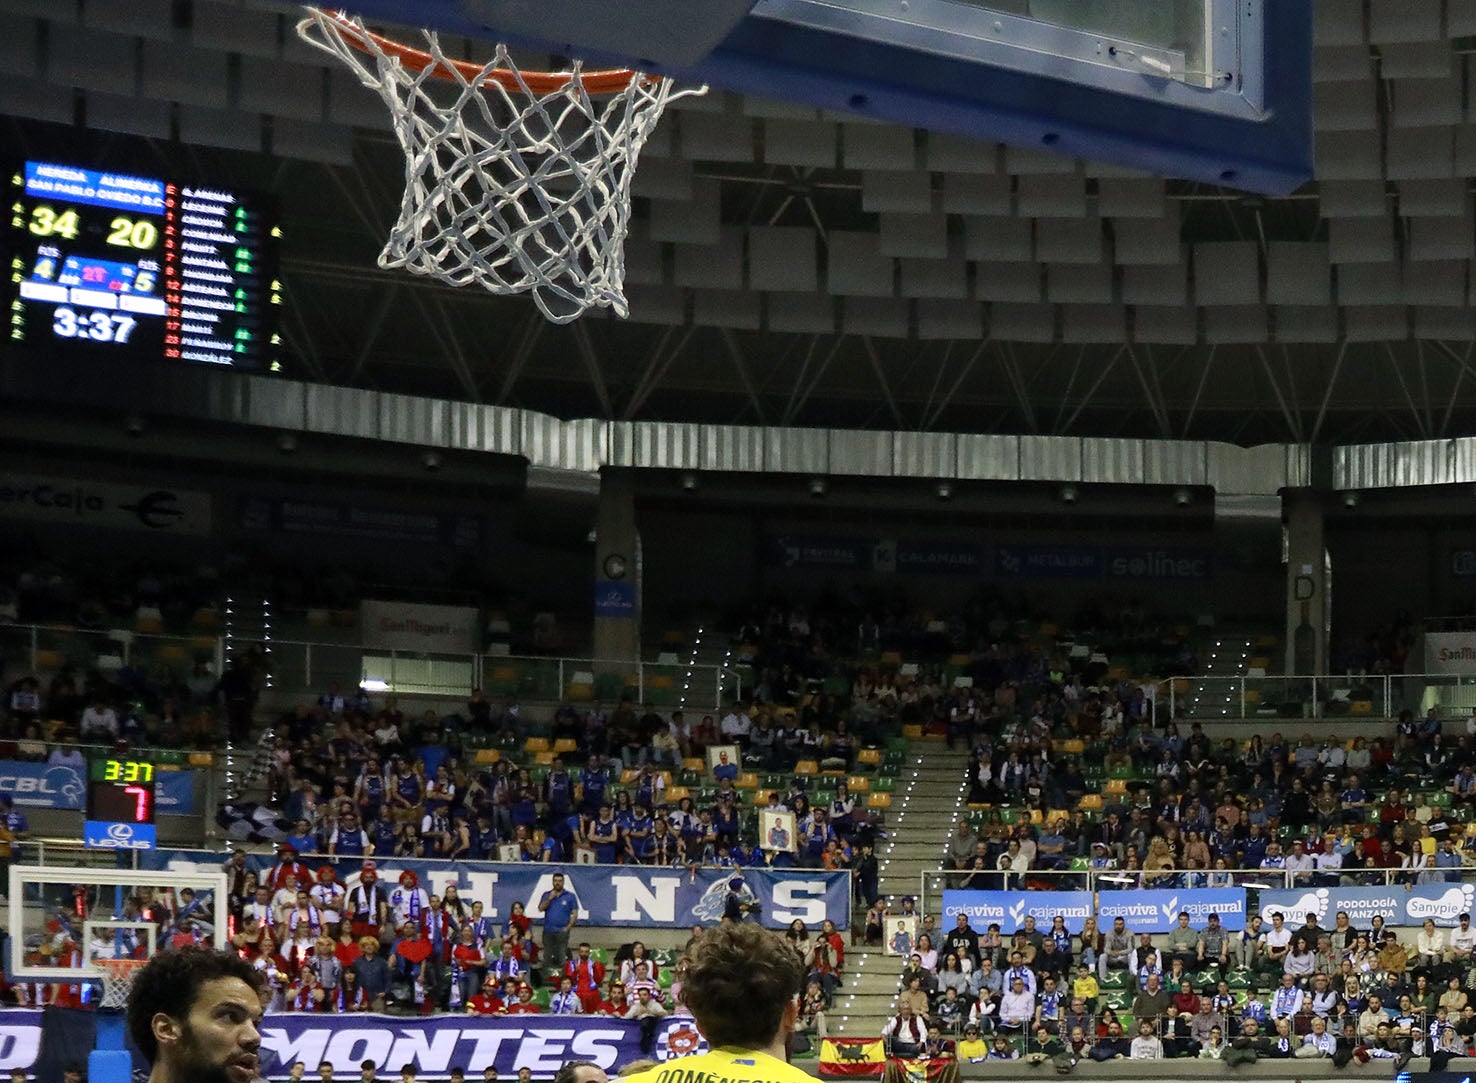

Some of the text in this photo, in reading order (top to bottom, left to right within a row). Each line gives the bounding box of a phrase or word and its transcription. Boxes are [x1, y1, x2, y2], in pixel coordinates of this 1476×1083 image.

[29, 206, 80, 240] 34
[106, 217, 158, 250] 20
[33, 258, 56, 279] 4
[134, 272, 156, 291] 5
[53, 306, 138, 344] 3:37
[104, 760, 154, 782] 3:37
[125, 785, 149, 822] 7
[1336, 896, 1398, 910] PODOLOGÍA
[1410, 901, 1458, 917] Sanypie
[260, 1029, 625, 1073] MONTES
